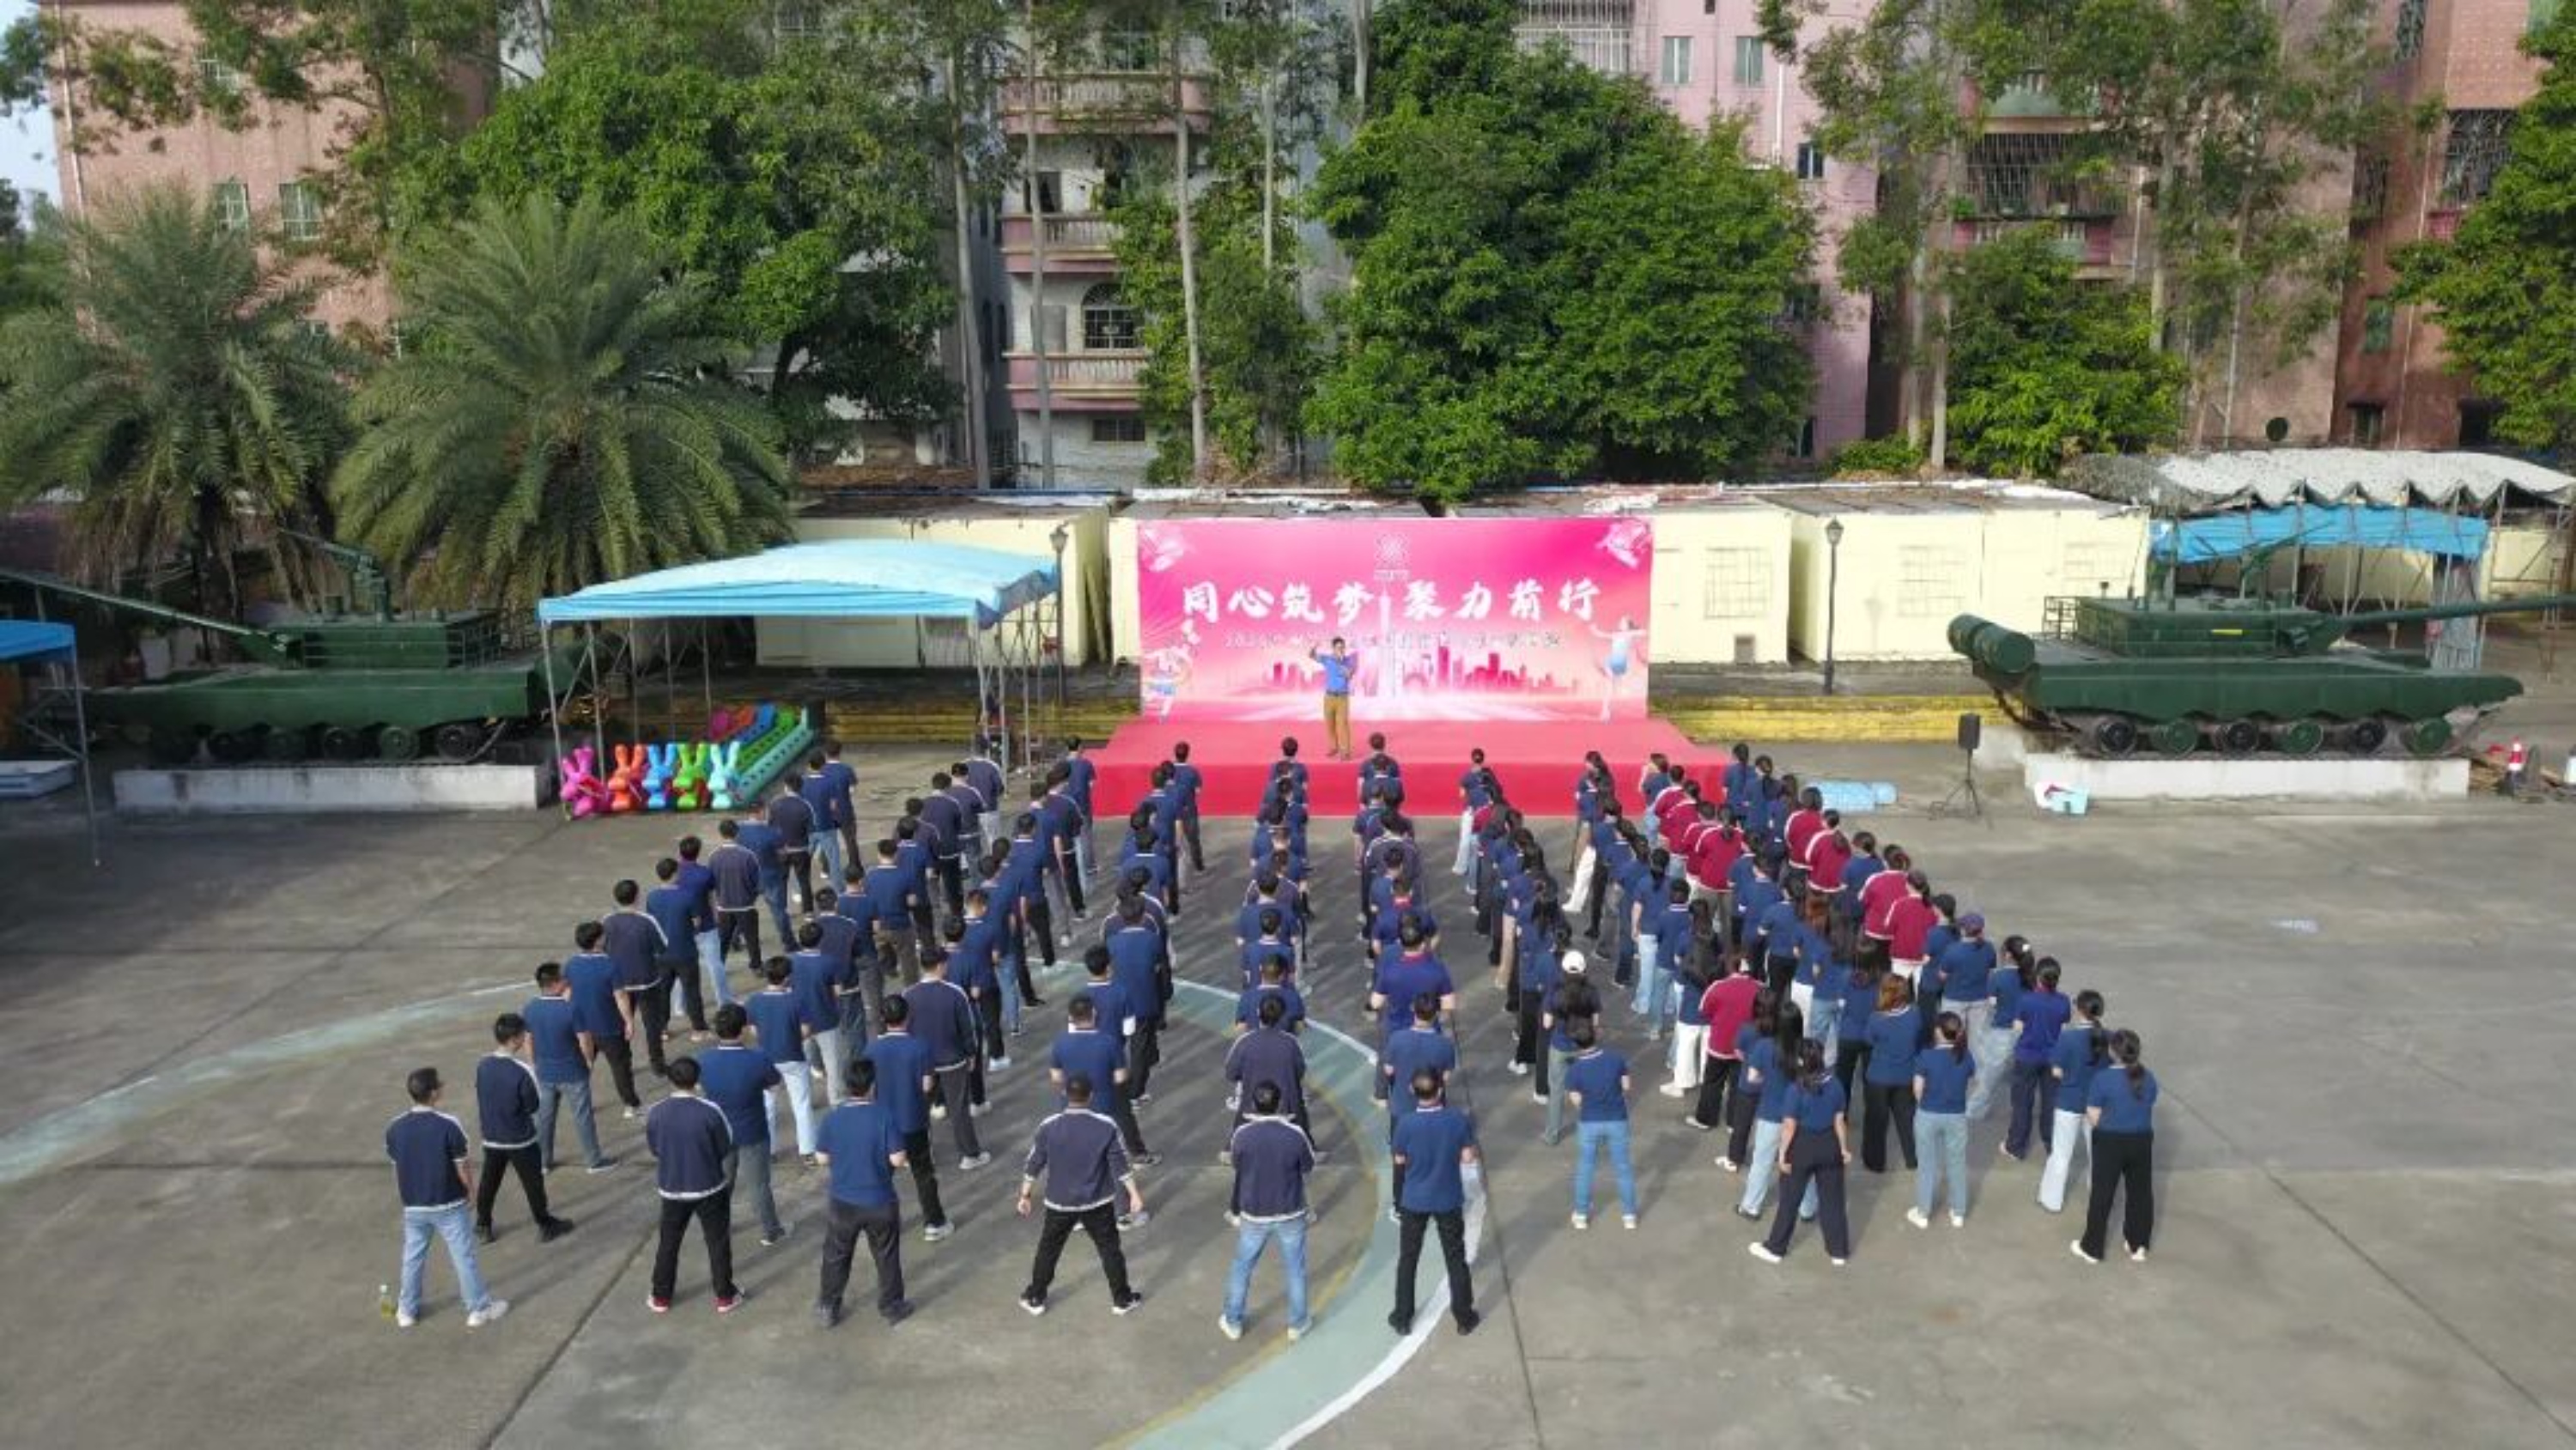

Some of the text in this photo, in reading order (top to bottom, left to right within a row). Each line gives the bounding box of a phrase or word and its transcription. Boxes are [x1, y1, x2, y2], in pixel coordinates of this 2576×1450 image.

[1182, 577, 1601, 627] 同心筑梦 聚力前行
